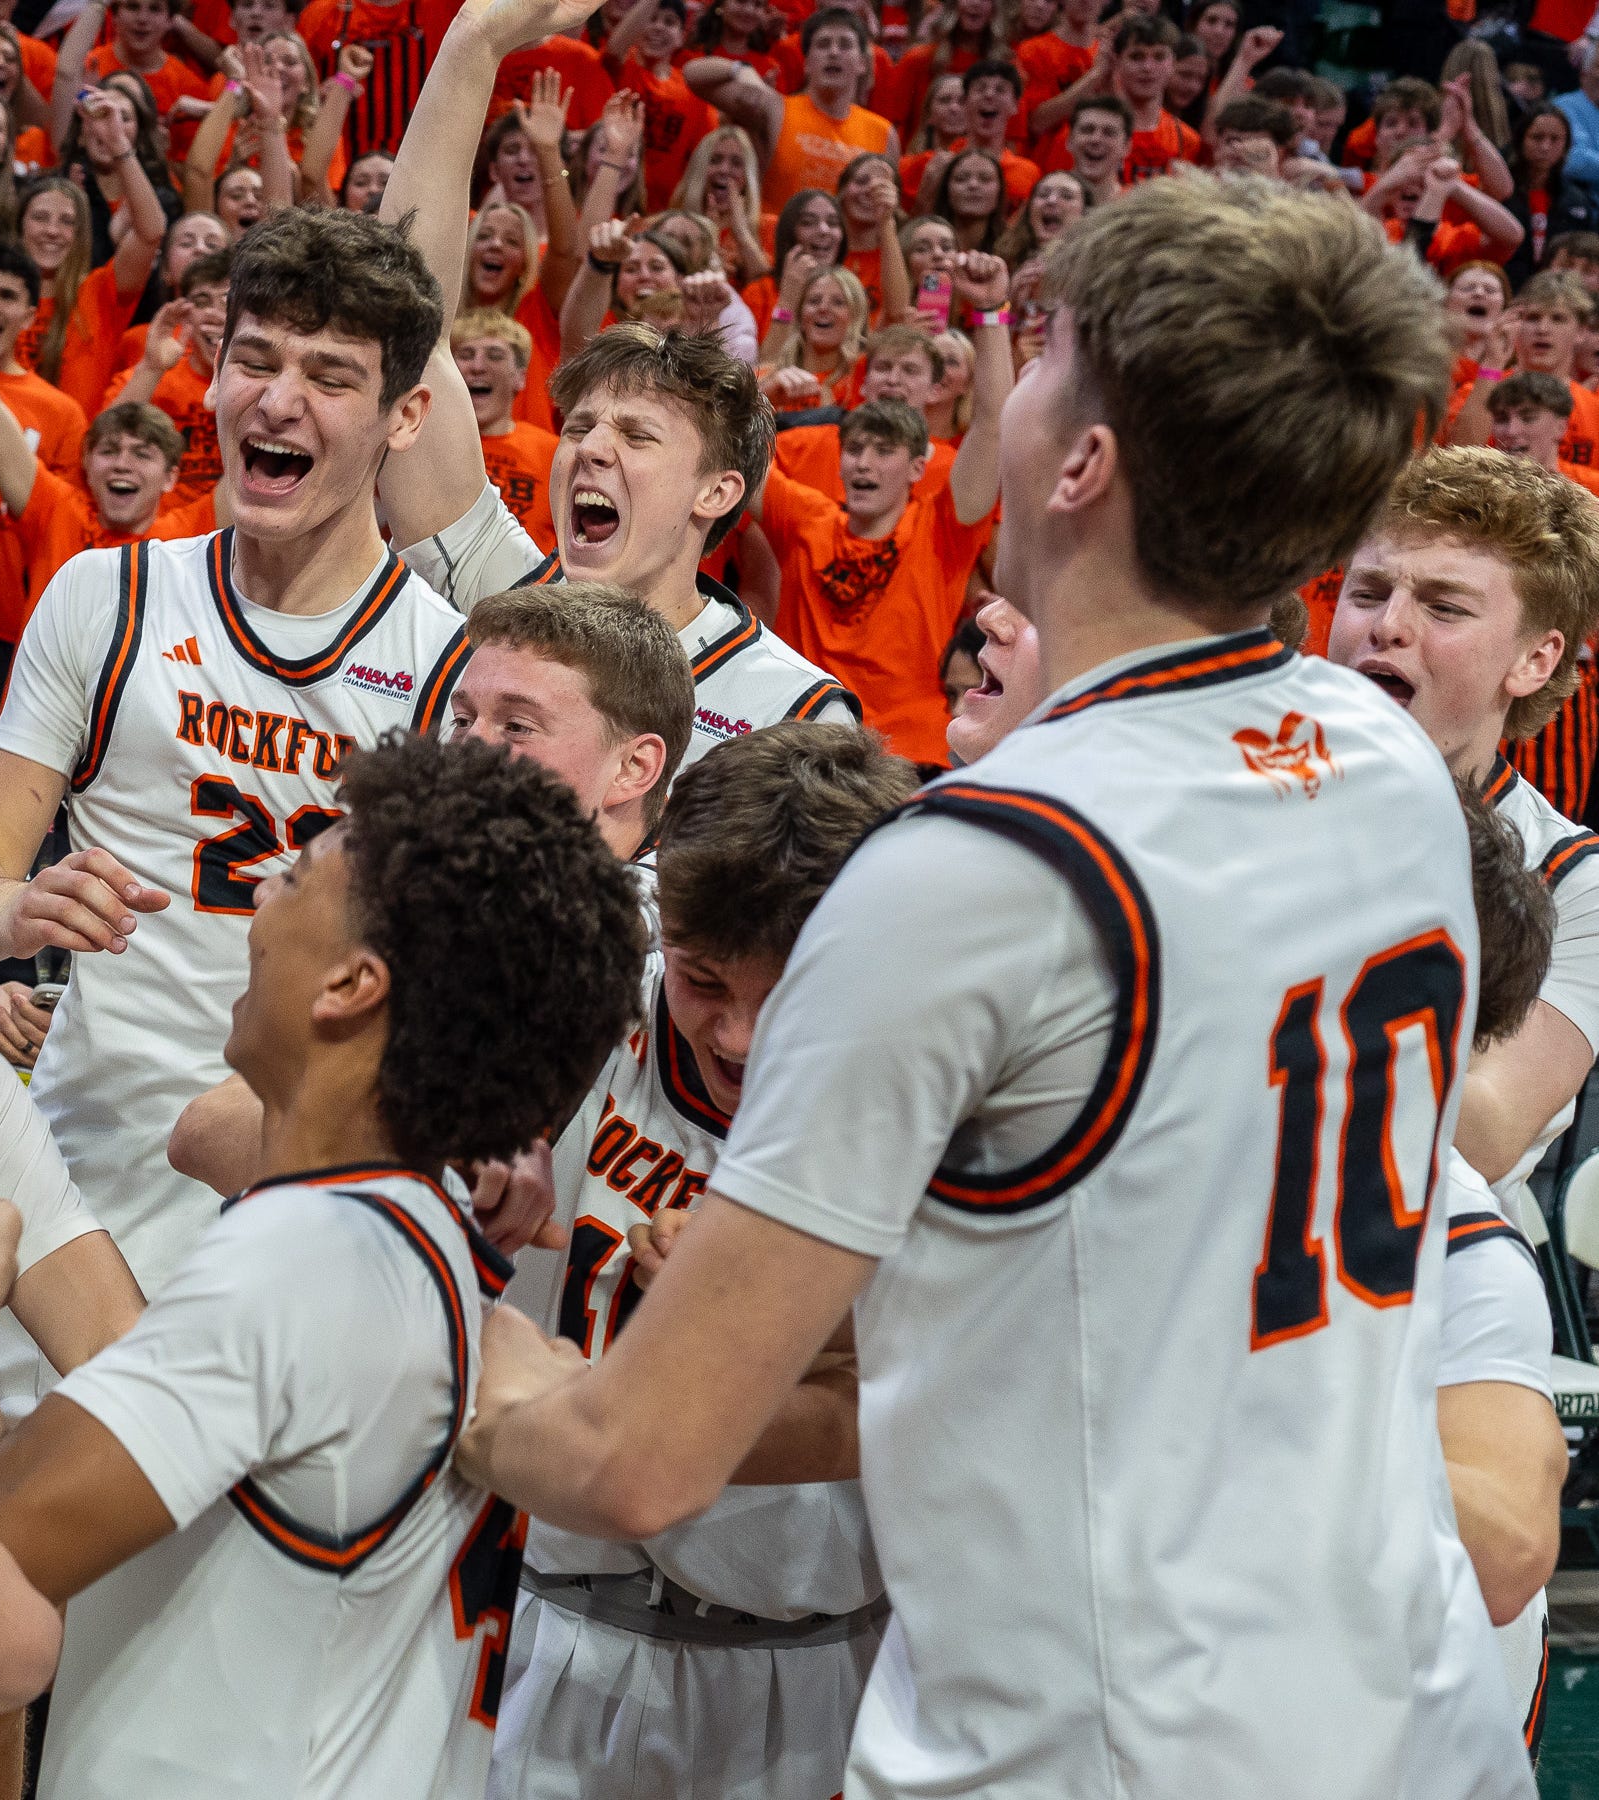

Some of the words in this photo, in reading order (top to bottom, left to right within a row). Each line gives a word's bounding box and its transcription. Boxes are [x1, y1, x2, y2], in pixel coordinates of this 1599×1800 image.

[342, 676, 411, 702] CHAMPIONSHIPS
[693, 721, 733, 741] HAMPIONS
[588, 1092, 711, 1220] OCKF
[1249, 926, 1467, 1354] 10
[558, 1214, 645, 1361] 1
